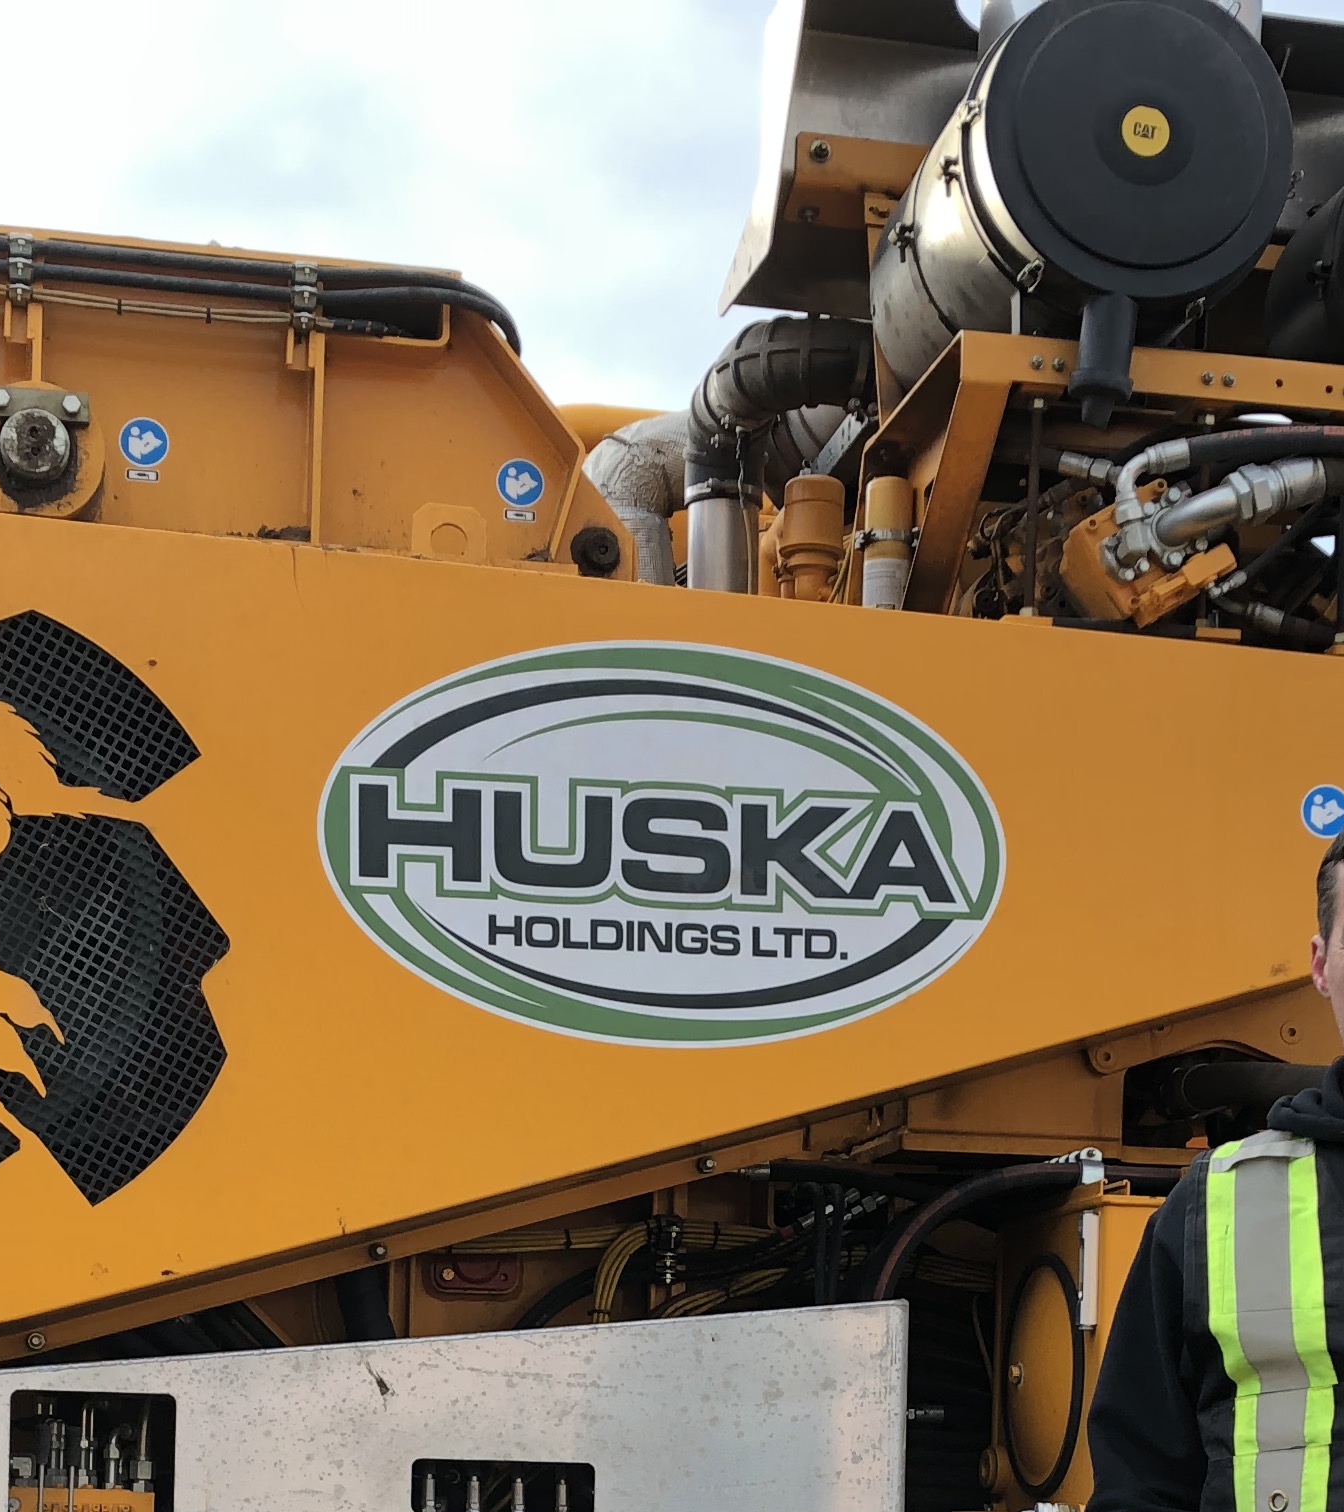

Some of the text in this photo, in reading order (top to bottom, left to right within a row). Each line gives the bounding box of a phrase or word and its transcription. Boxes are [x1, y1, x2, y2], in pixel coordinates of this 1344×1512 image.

[1133, 121, 1158, 140] CAT
[358, 783, 955, 904] HUSKA
[488, 914, 849, 961] HOLDINGS LTD.
